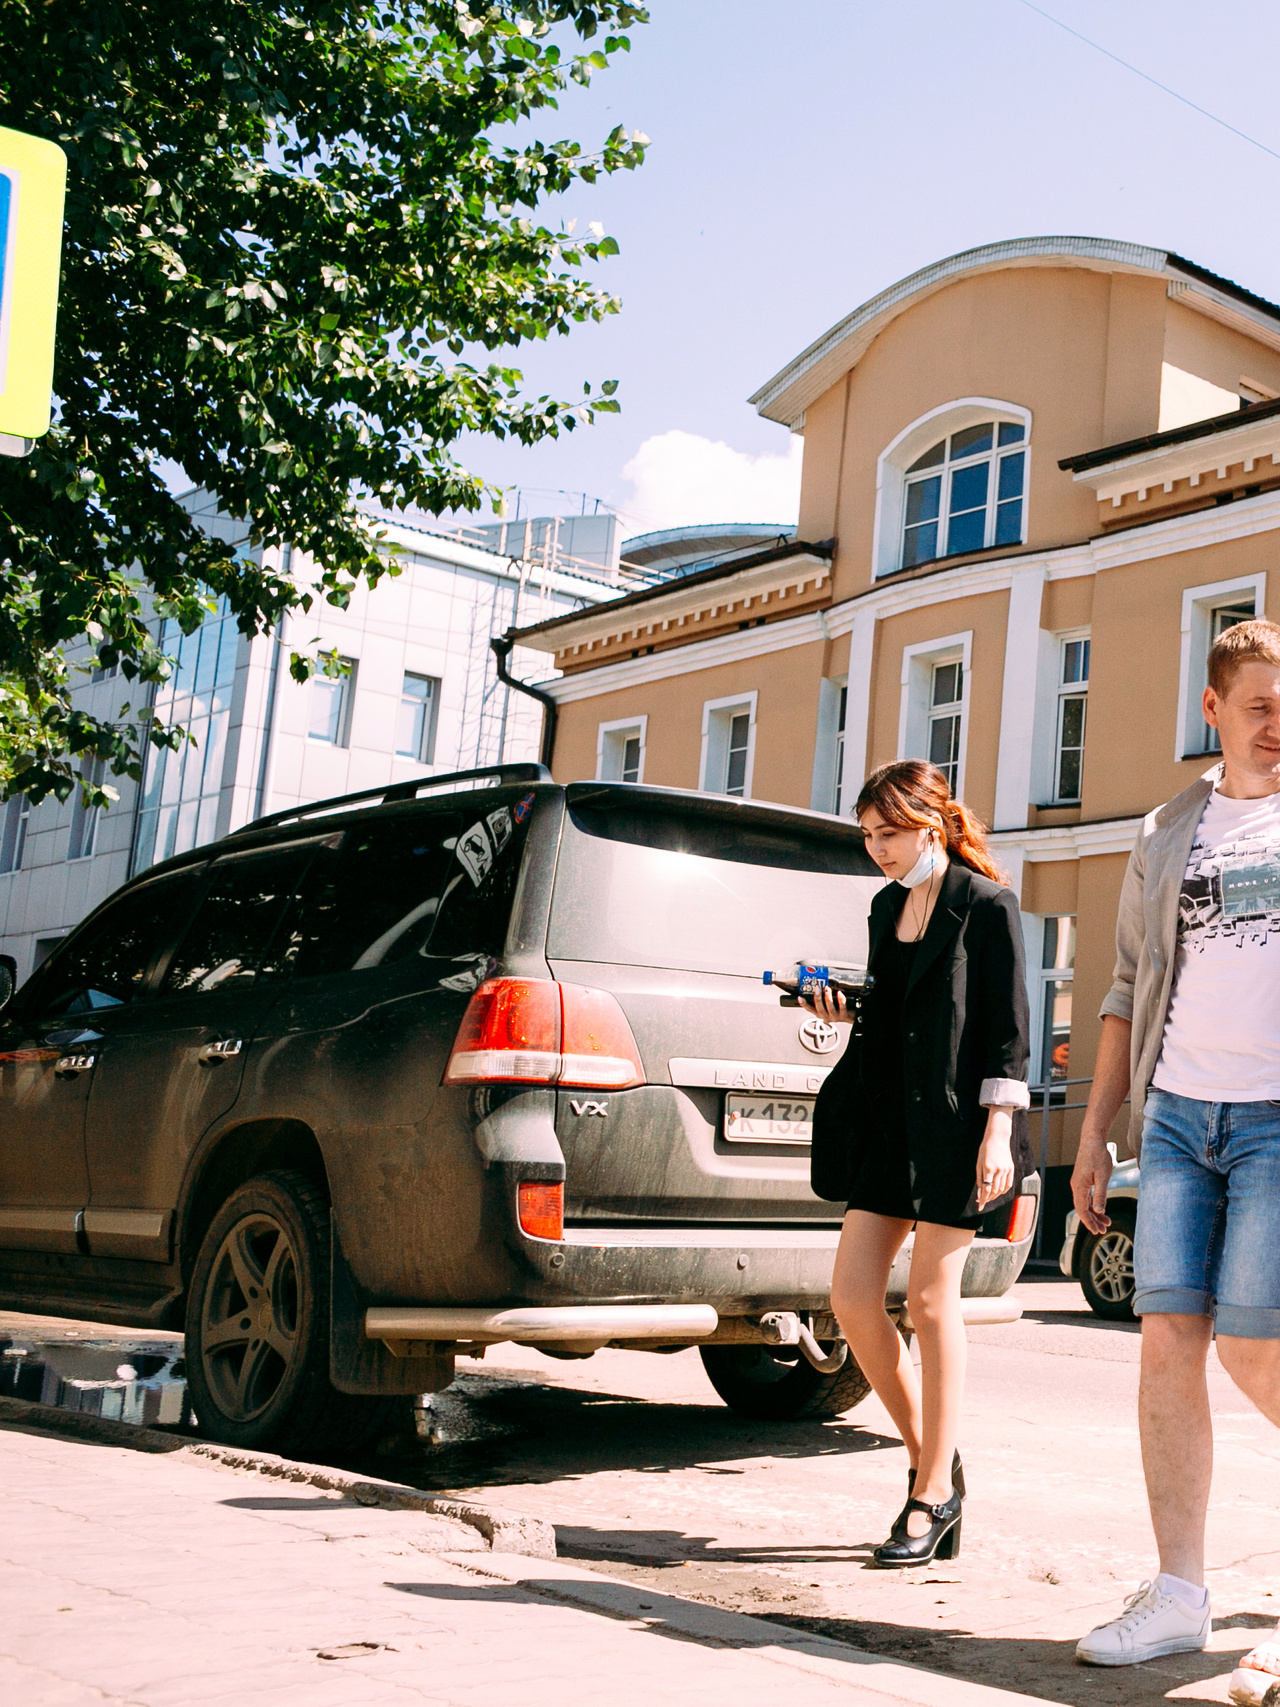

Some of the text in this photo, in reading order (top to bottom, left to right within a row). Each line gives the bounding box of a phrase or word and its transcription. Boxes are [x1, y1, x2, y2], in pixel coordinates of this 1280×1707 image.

[1228, 880, 1257, 889] MOVE
[714, 1069, 786, 1089] LAND
[569, 1099, 609, 1117] VX
